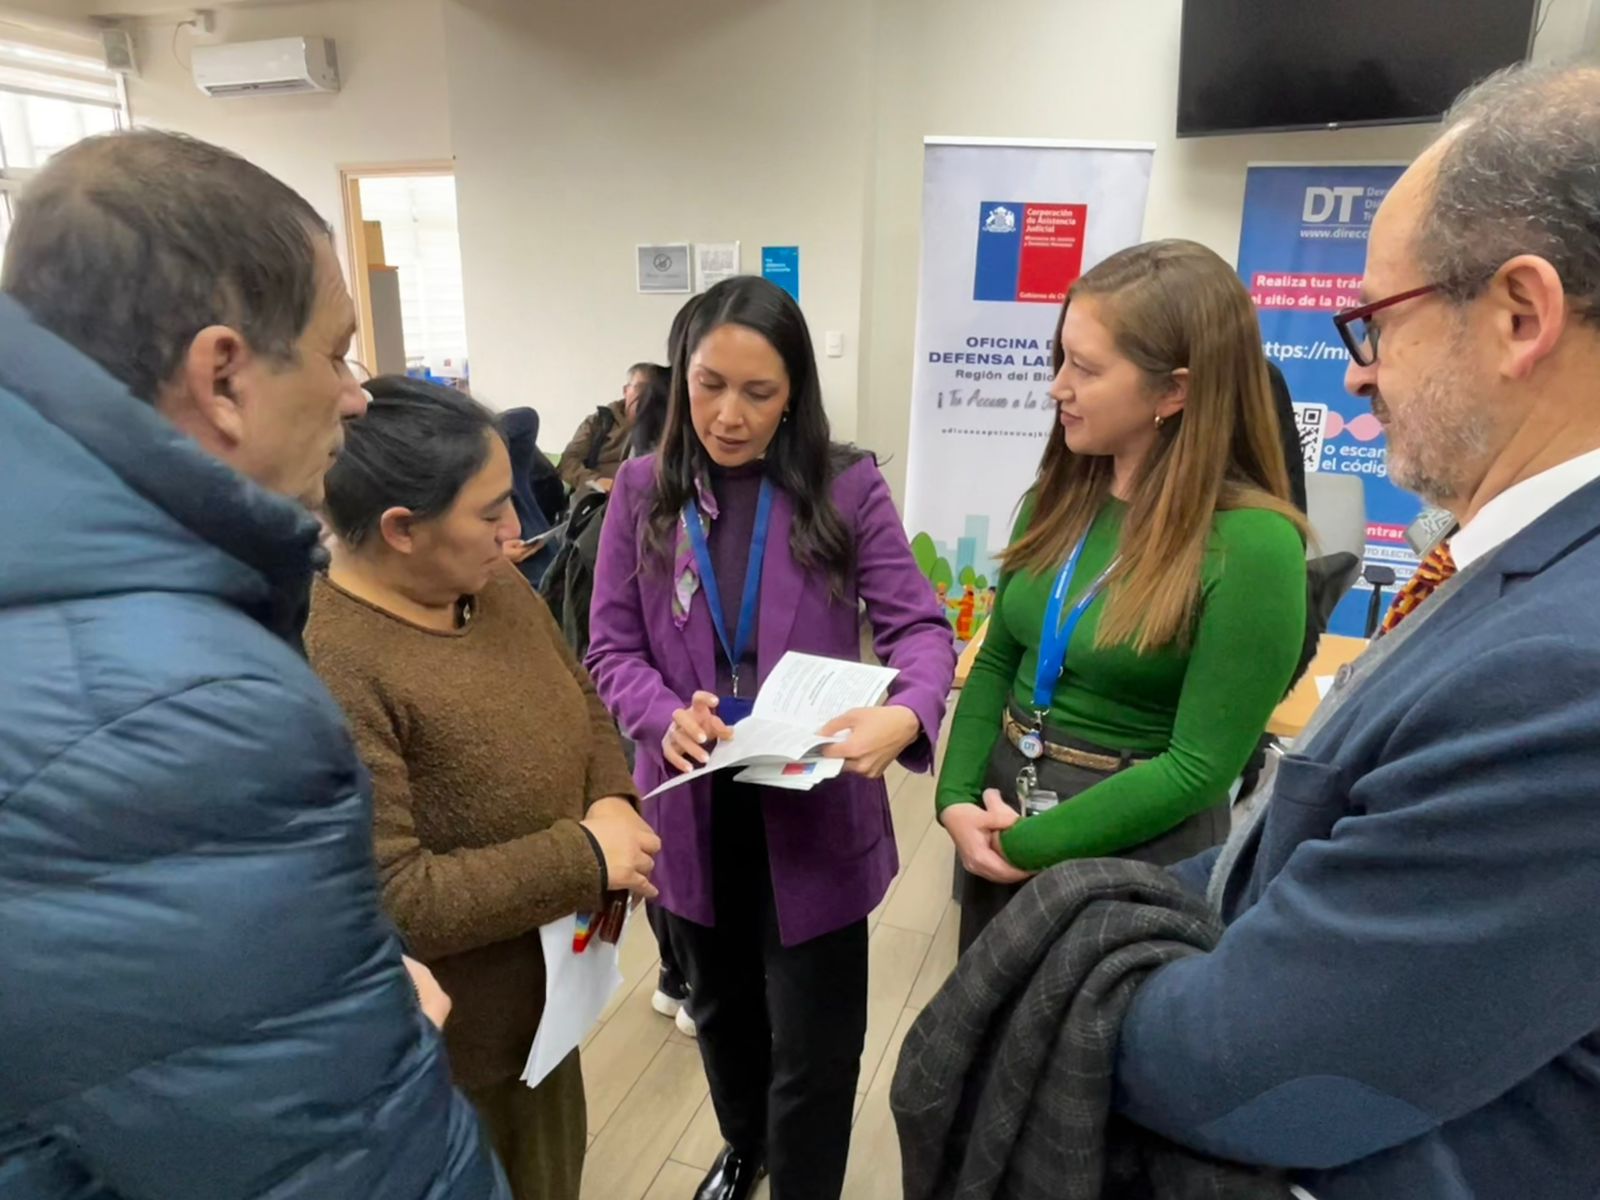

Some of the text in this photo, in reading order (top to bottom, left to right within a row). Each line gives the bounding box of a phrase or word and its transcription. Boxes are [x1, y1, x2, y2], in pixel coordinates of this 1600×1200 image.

[1302, 186, 1364, 223] DT
[1256, 275, 1307, 288] Realiza
[1311, 277, 1333, 288] tus
[1264, 295, 1296, 306] sitio
[1298, 296, 1316, 306] de
[1319, 296, 1332, 307] la
[966, 337, 1039, 350] OFICINA
[928, 351, 1015, 366] DEFENSA
[955, 369, 1002, 381] Región
[1007, 371, 1028, 380] del
[1321, 458, 1337, 470] el
